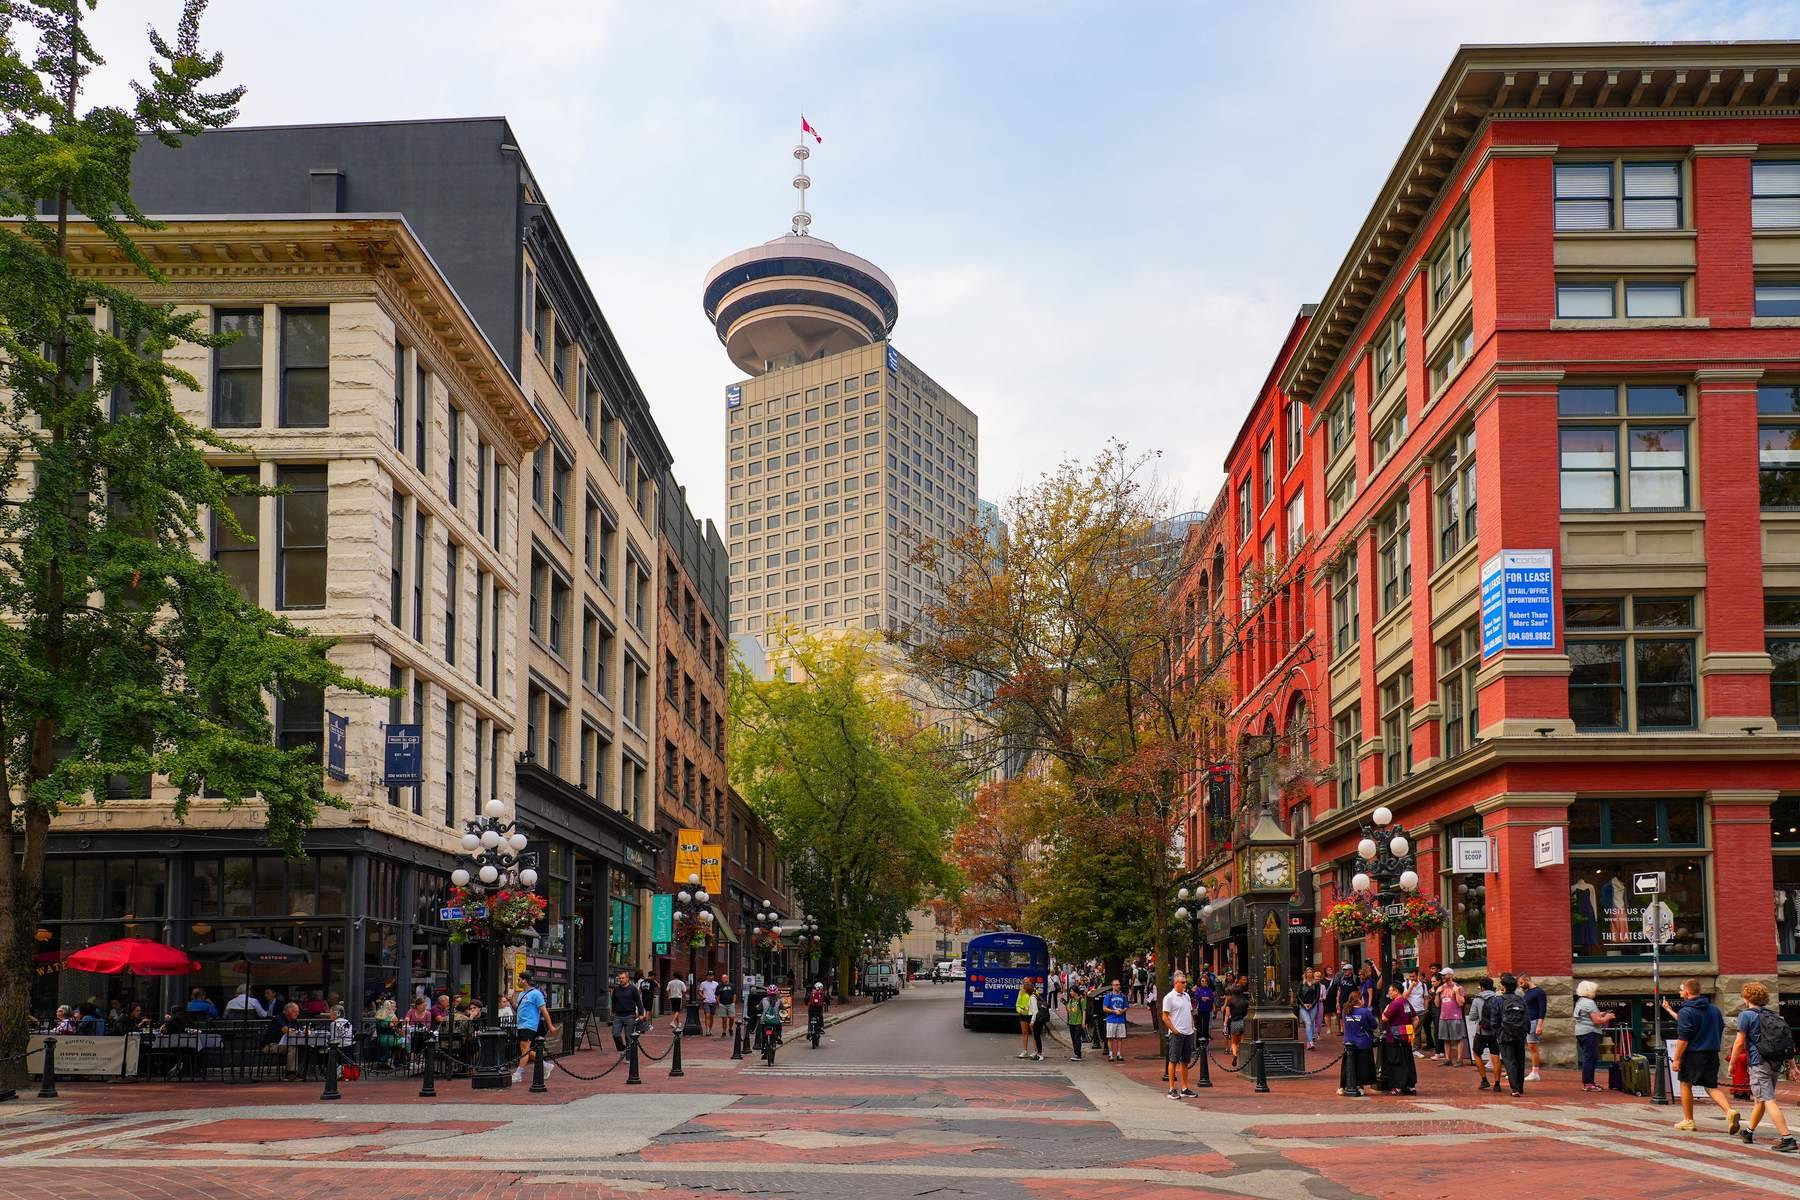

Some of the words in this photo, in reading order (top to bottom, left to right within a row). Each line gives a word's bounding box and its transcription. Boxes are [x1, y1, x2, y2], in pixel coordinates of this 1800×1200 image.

[1505, 572, 1522, 582] FOR
[1524, 572, 1550, 582] LEASE
[1507, 587, 1548, 595] RETAIL/OFFICE
[1506, 596, 1550, 604] OPPORTUNITIES
[1509, 611, 1530, 619] Robert
[1513, 619, 1530, 627] Marc
[1603, 907, 1624, 915] VISIT
[1626, 907, 1638, 915] US
[1601, 932, 1617, 940] THE
[35, 961, 67, 977] WATE
[984, 976, 1023, 984] SIGHTSEEIN
